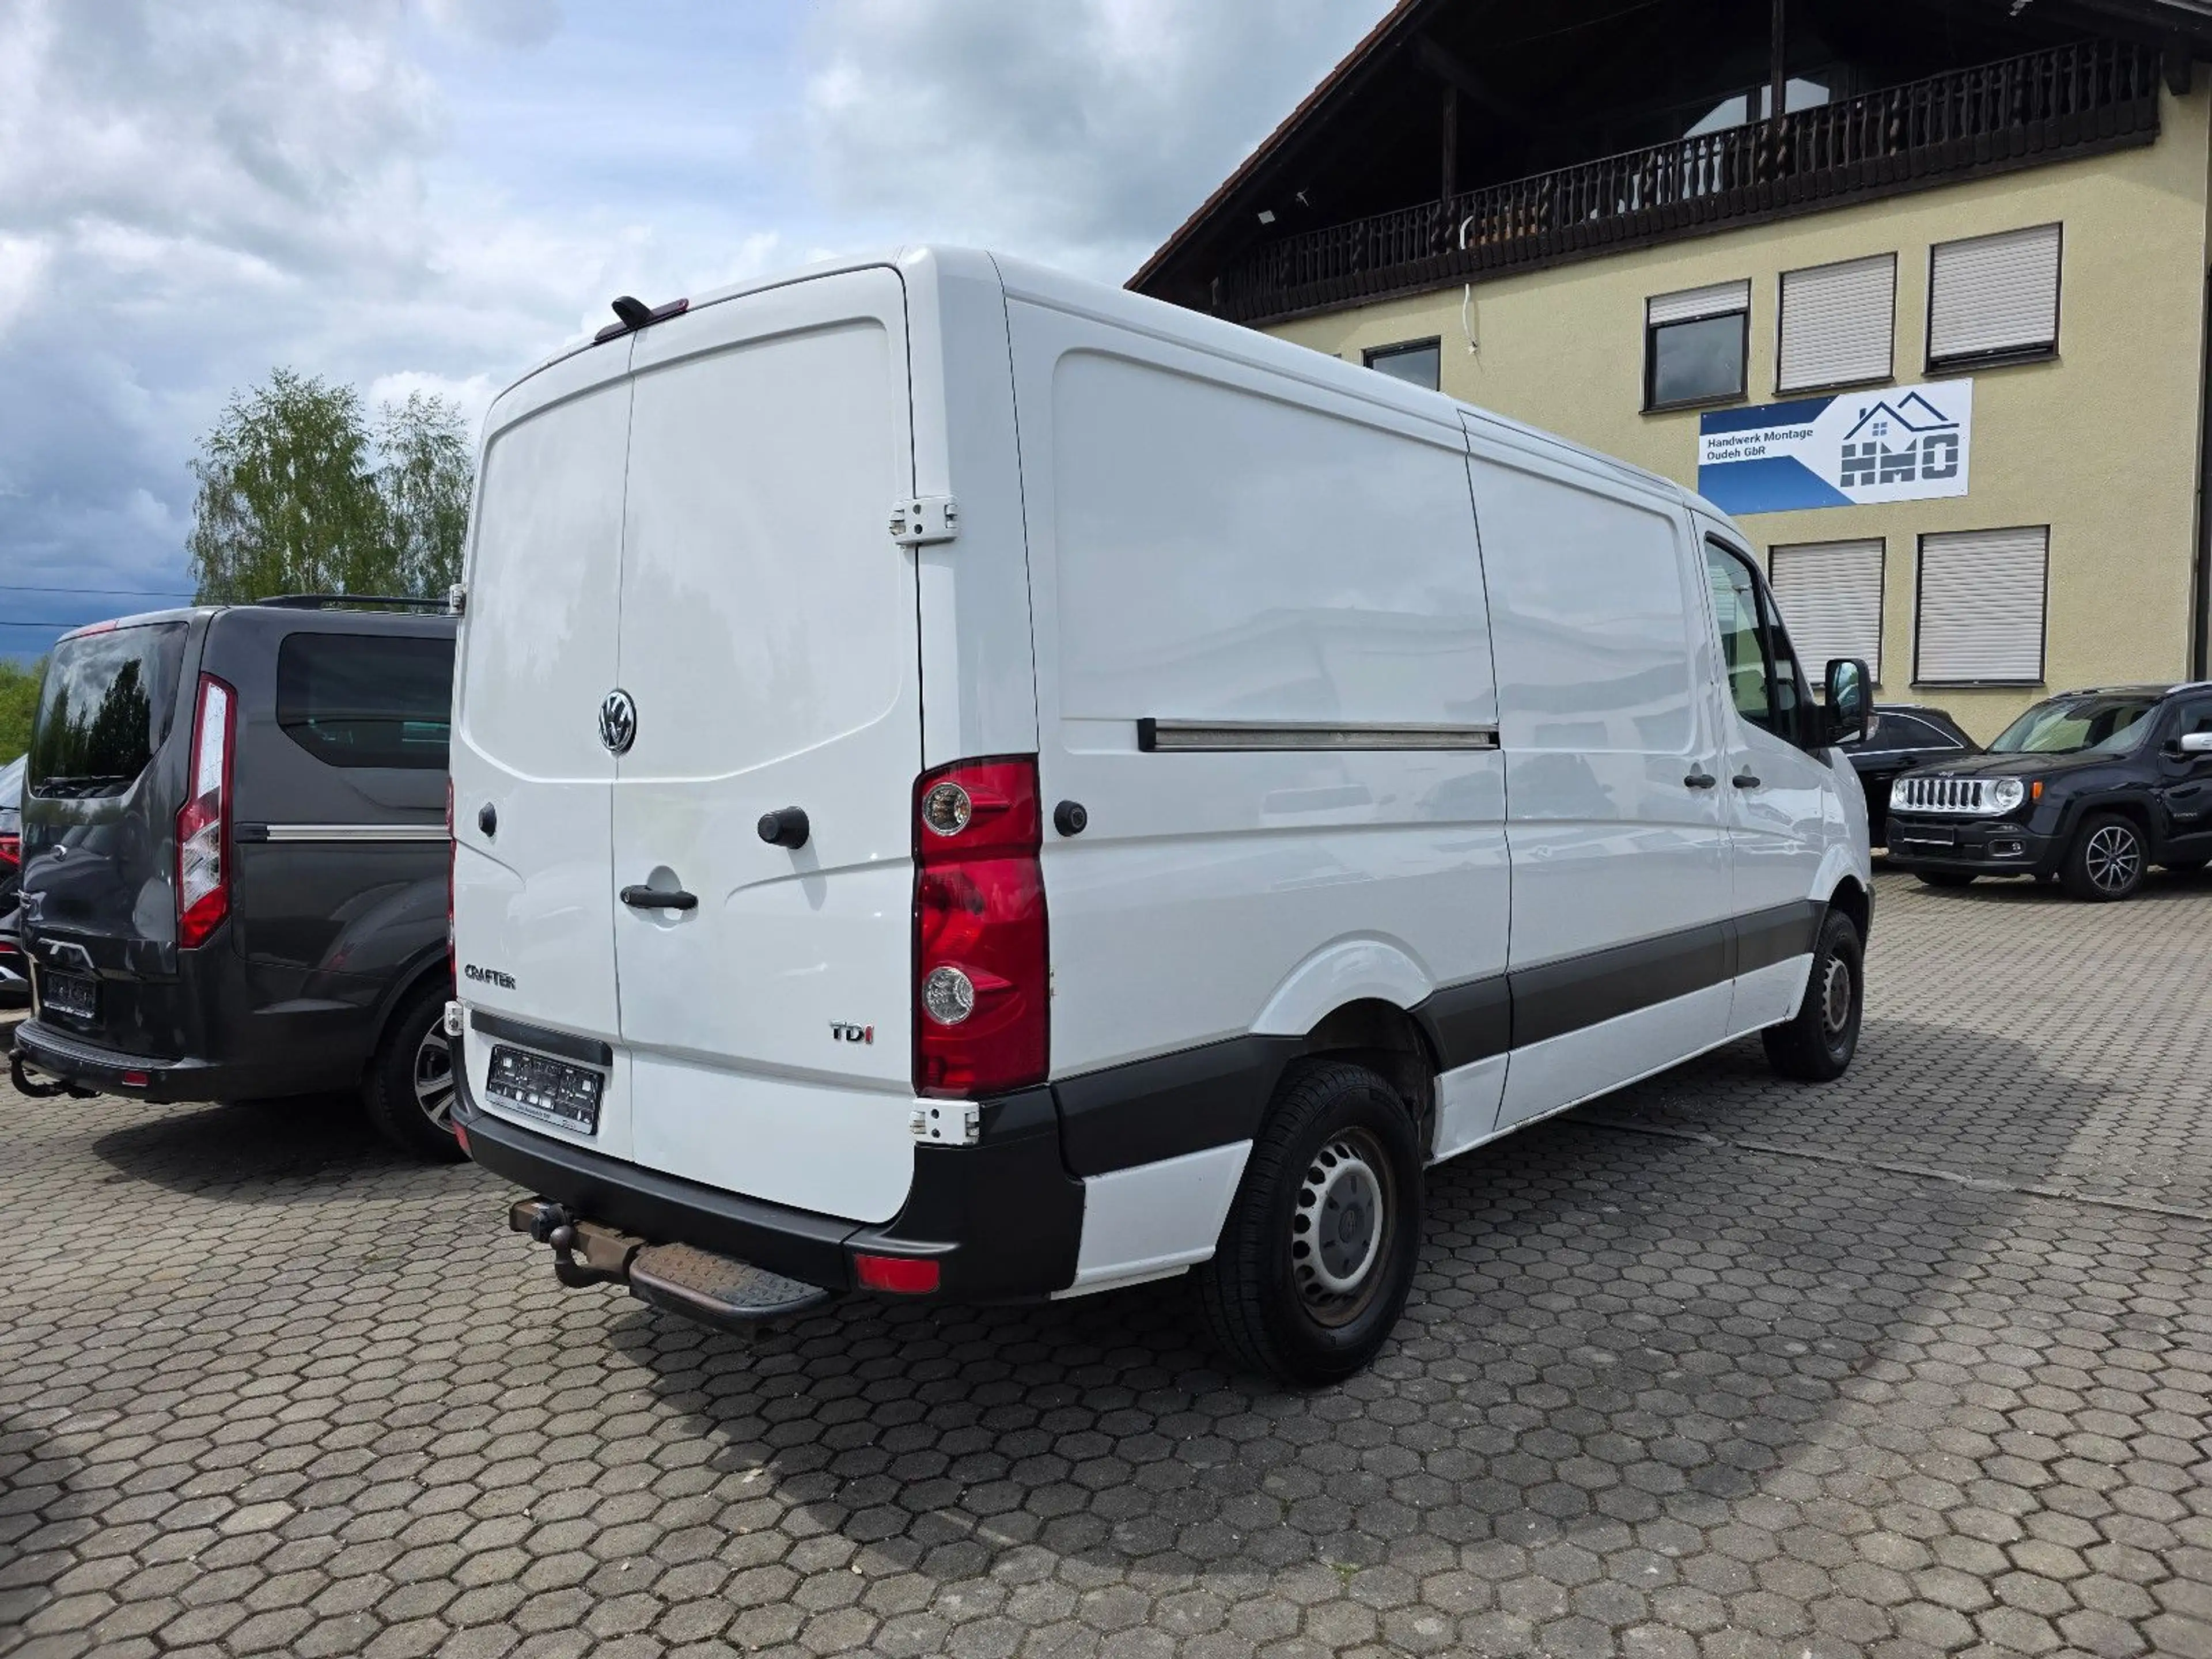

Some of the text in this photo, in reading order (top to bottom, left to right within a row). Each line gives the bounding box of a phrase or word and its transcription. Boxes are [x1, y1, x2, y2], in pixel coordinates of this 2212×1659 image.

[1708, 429, 1813, 448] Handwerk Montage
[1707, 446, 1766, 460] Oudeh GbR
[464, 964, 516, 990] CRAFTER
